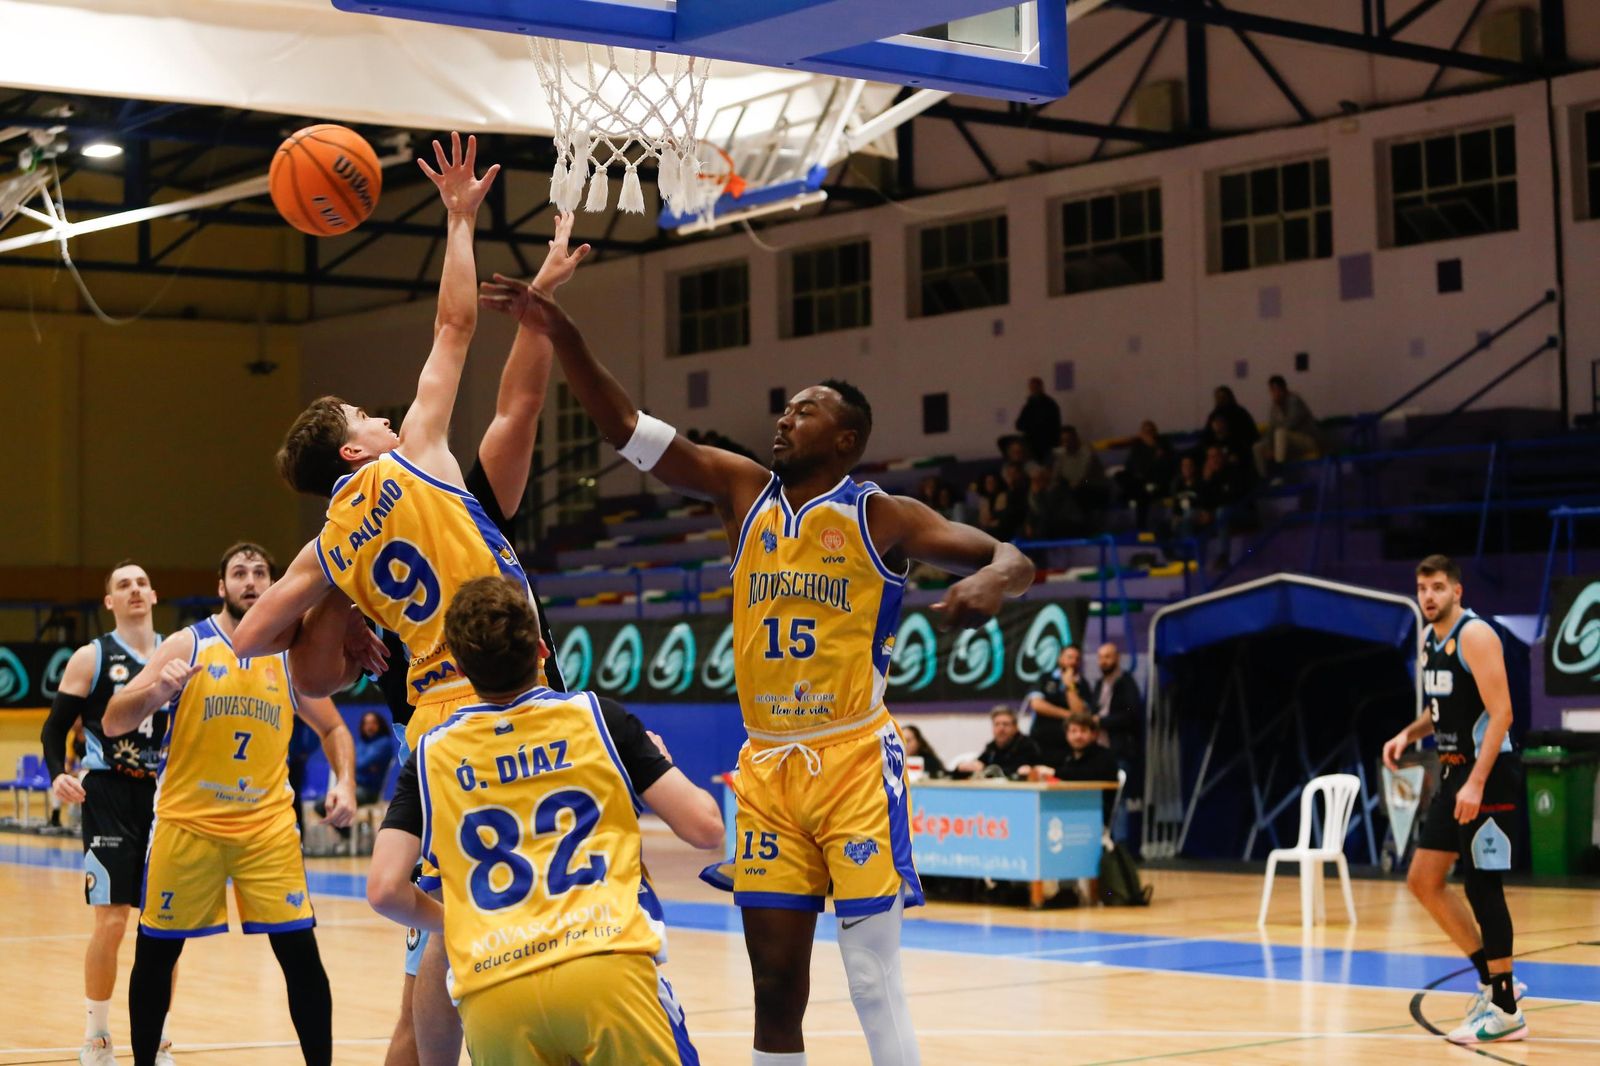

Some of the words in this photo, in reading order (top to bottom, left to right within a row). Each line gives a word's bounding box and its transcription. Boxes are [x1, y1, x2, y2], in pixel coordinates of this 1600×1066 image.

[329, 545, 353, 572] V.
[822, 555, 846, 564] vive
[372, 537, 441, 623] 9
[747, 571, 852, 613] NOVSCHOOL
[763, 617, 816, 660] 15
[203, 695, 282, 731] NOVASCHOOL
[233, 731, 251, 760] 7
[455, 758, 488, 792] Ó.
[495, 739, 573, 784] DÍAZ
[457, 786, 609, 914] 82
[742, 831, 779, 860] 15
[745, 867, 767, 875] vive
[161, 891, 175, 910] 7
[471, 904, 619, 957] NOVASCHOOL
[474, 939, 558, 973] education
[565, 928, 588, 946] for
[594, 925, 622, 938] life
